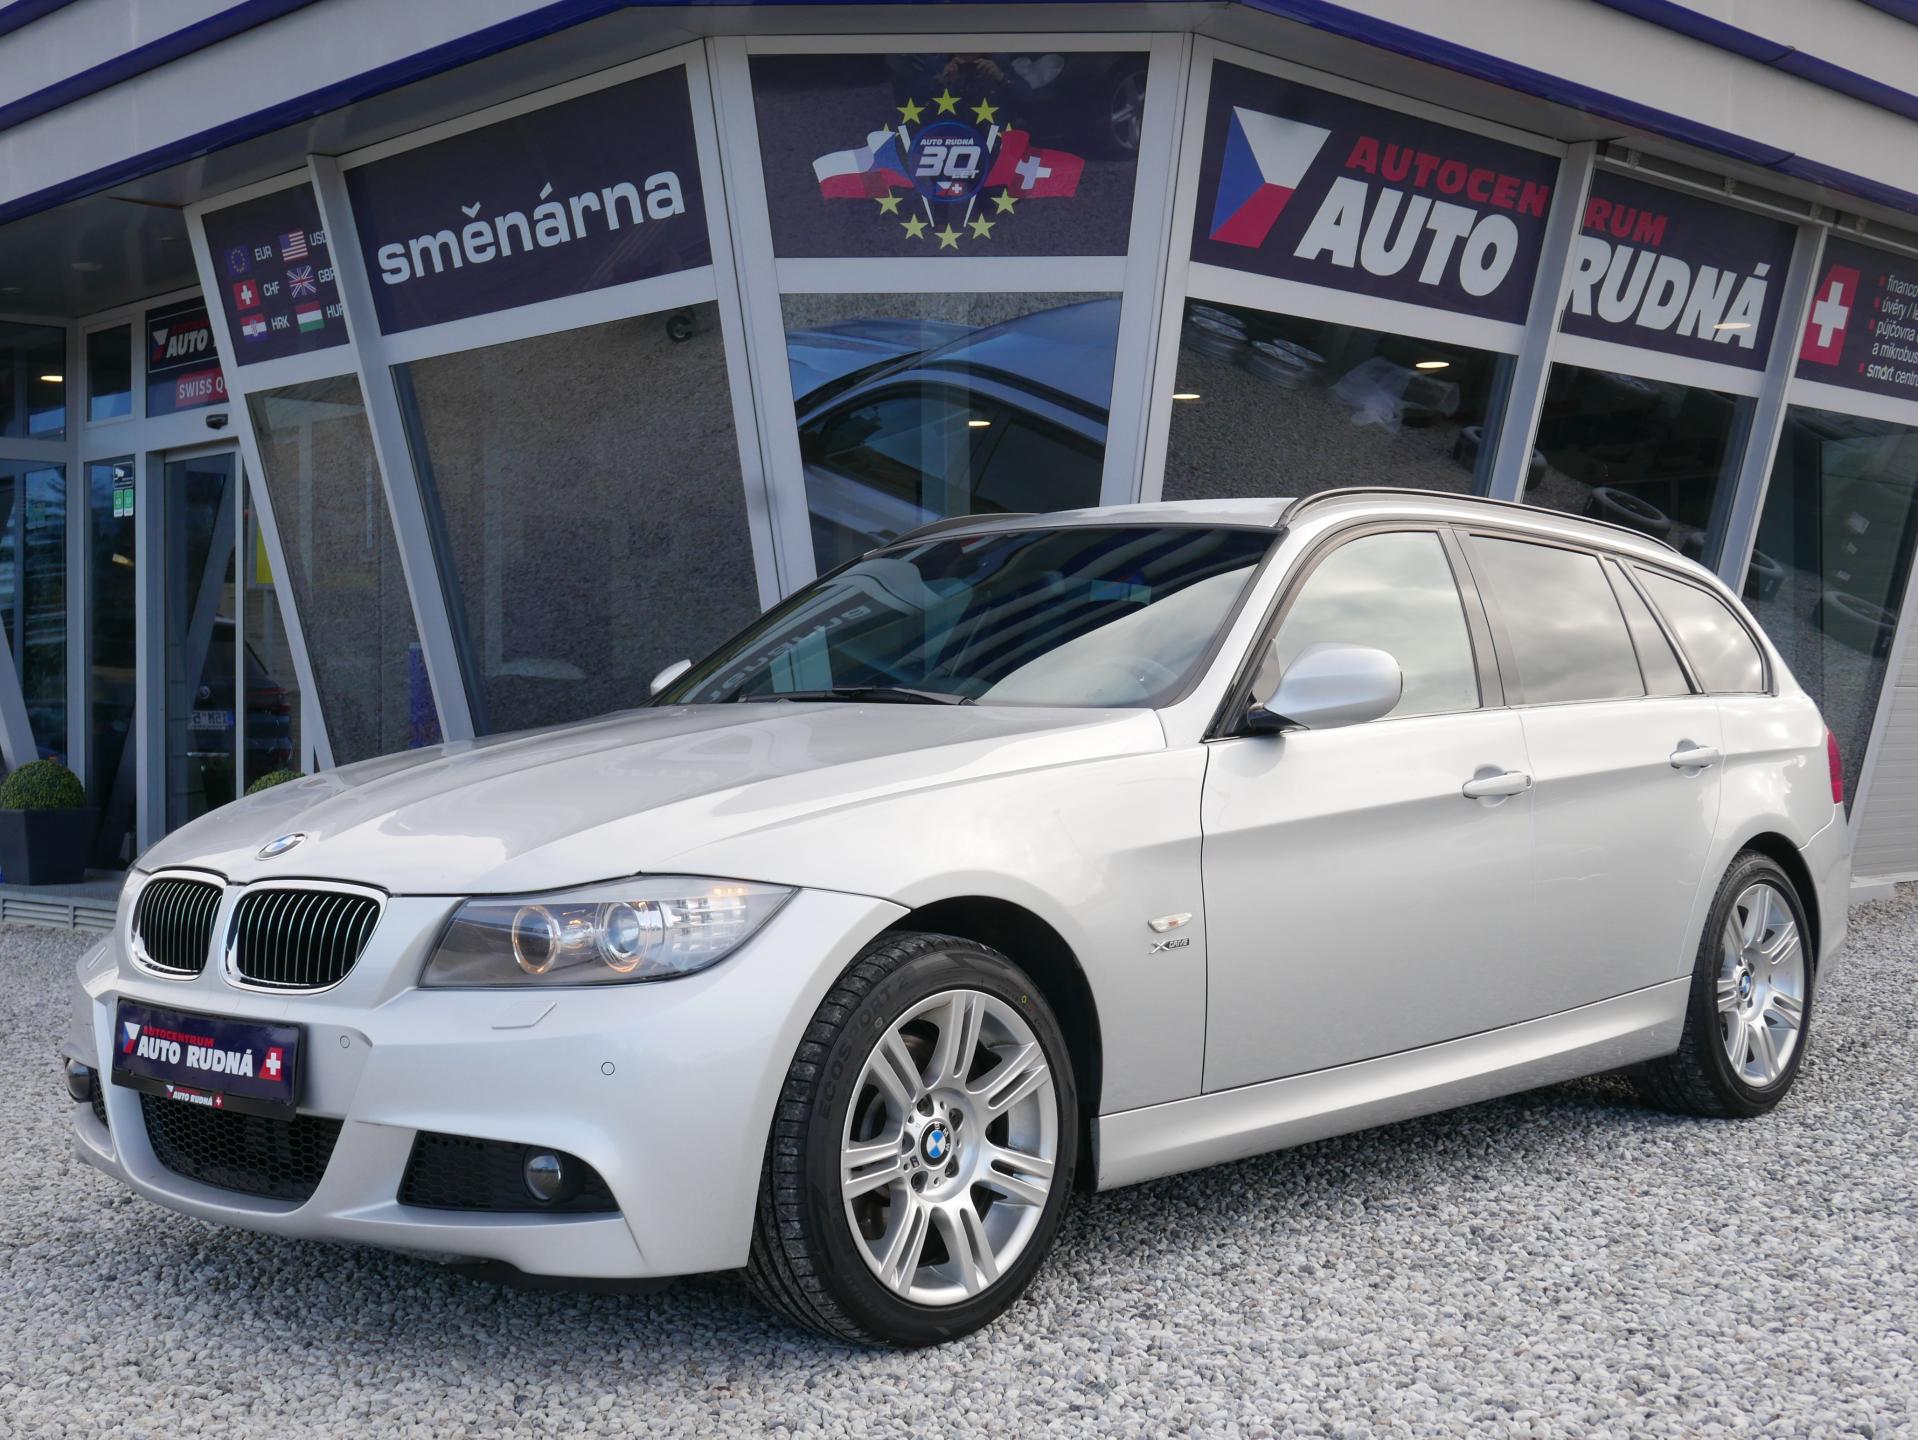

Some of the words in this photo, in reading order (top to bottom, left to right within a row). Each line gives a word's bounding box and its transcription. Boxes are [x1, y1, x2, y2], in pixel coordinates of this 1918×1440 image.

[915, 145, 981, 177] 30
[377, 170, 686, 285] směnárna
[254, 245, 273, 261] EUR
[1293, 175, 1519, 297] AUTO
[1569, 234, 1771, 350] RUDNÁ
[263, 281, 280, 296] CHF
[271, 315, 290, 331] HRK
[166, 328, 209, 358] AUTO
[1872, 342, 1878, 355] a
[179, 378, 213, 399] SWISS
[143, 1025, 216, 1047] AUTOCENTRUM
[136, 1035, 181, 1064] AUTO
[186, 1045, 253, 1077] RUDNÁ
[173, 1091, 190, 1102] AUTO
